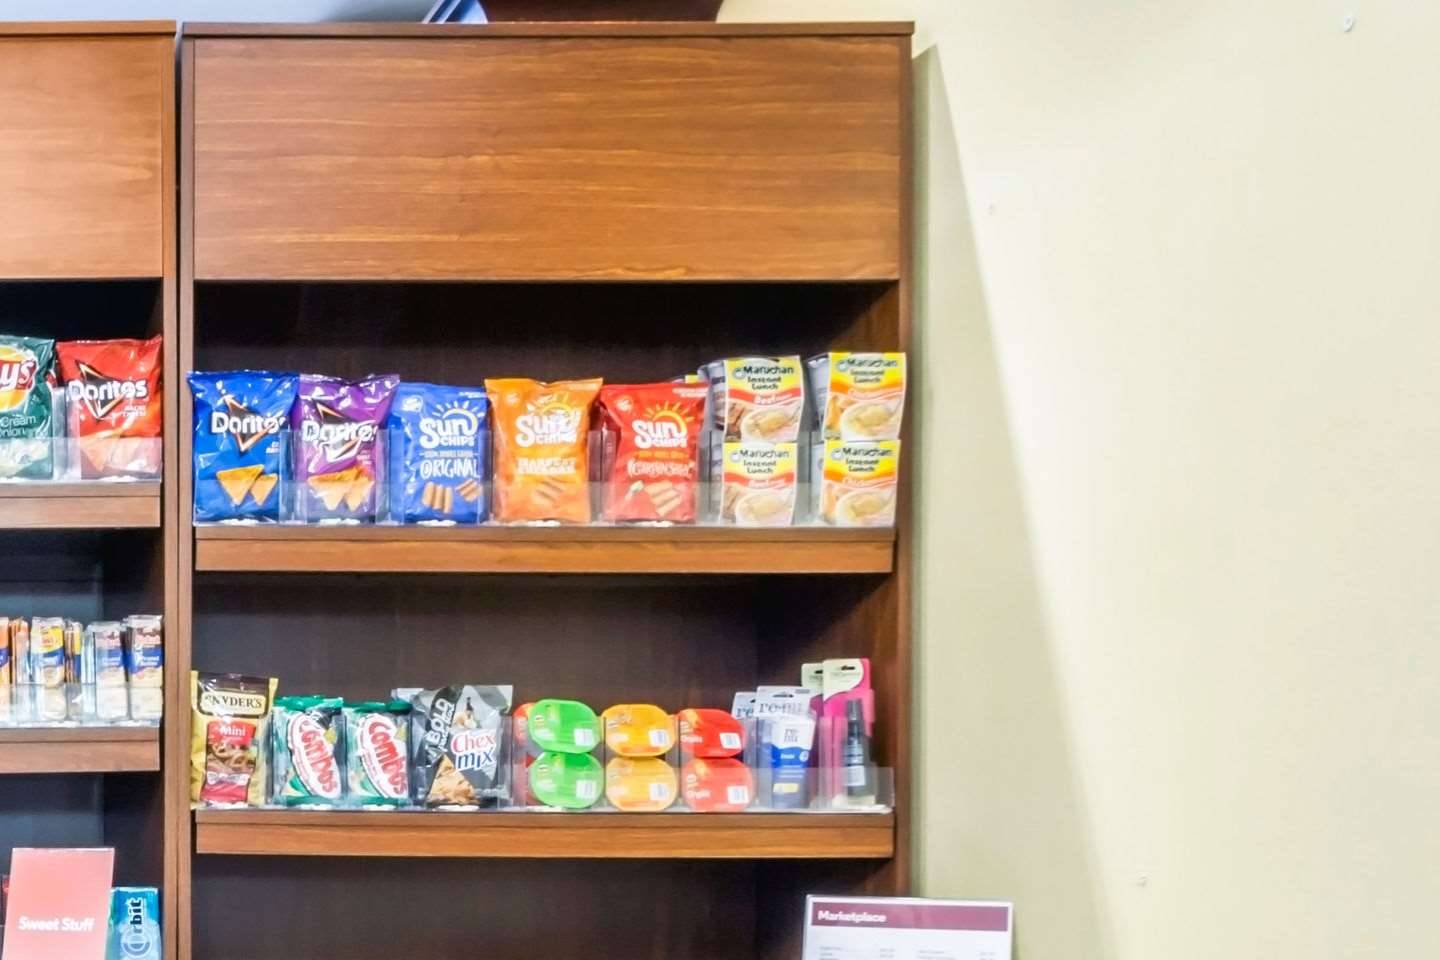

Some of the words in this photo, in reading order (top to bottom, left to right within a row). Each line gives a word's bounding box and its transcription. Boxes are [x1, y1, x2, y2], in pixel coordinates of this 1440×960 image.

[743, 365, 794, 374] Maruchan
[847, 359, 898, 368] Maruchan
[68, 380, 148, 400] Doritos
[632, 418, 688, 449] Sun
[740, 449, 790, 459] Maruchan
[842, 447, 893, 456] Maruchan
[420, 458, 480, 479] ORIGINAL
[452, 734, 494, 753] Chex
[368, 719, 408, 795] Combos
[457, 752, 493, 769] mix
[18, 916, 60, 931] Sweet
[61, 917, 96, 932] Stuff
[817, 910, 886, 924] Marketplace
